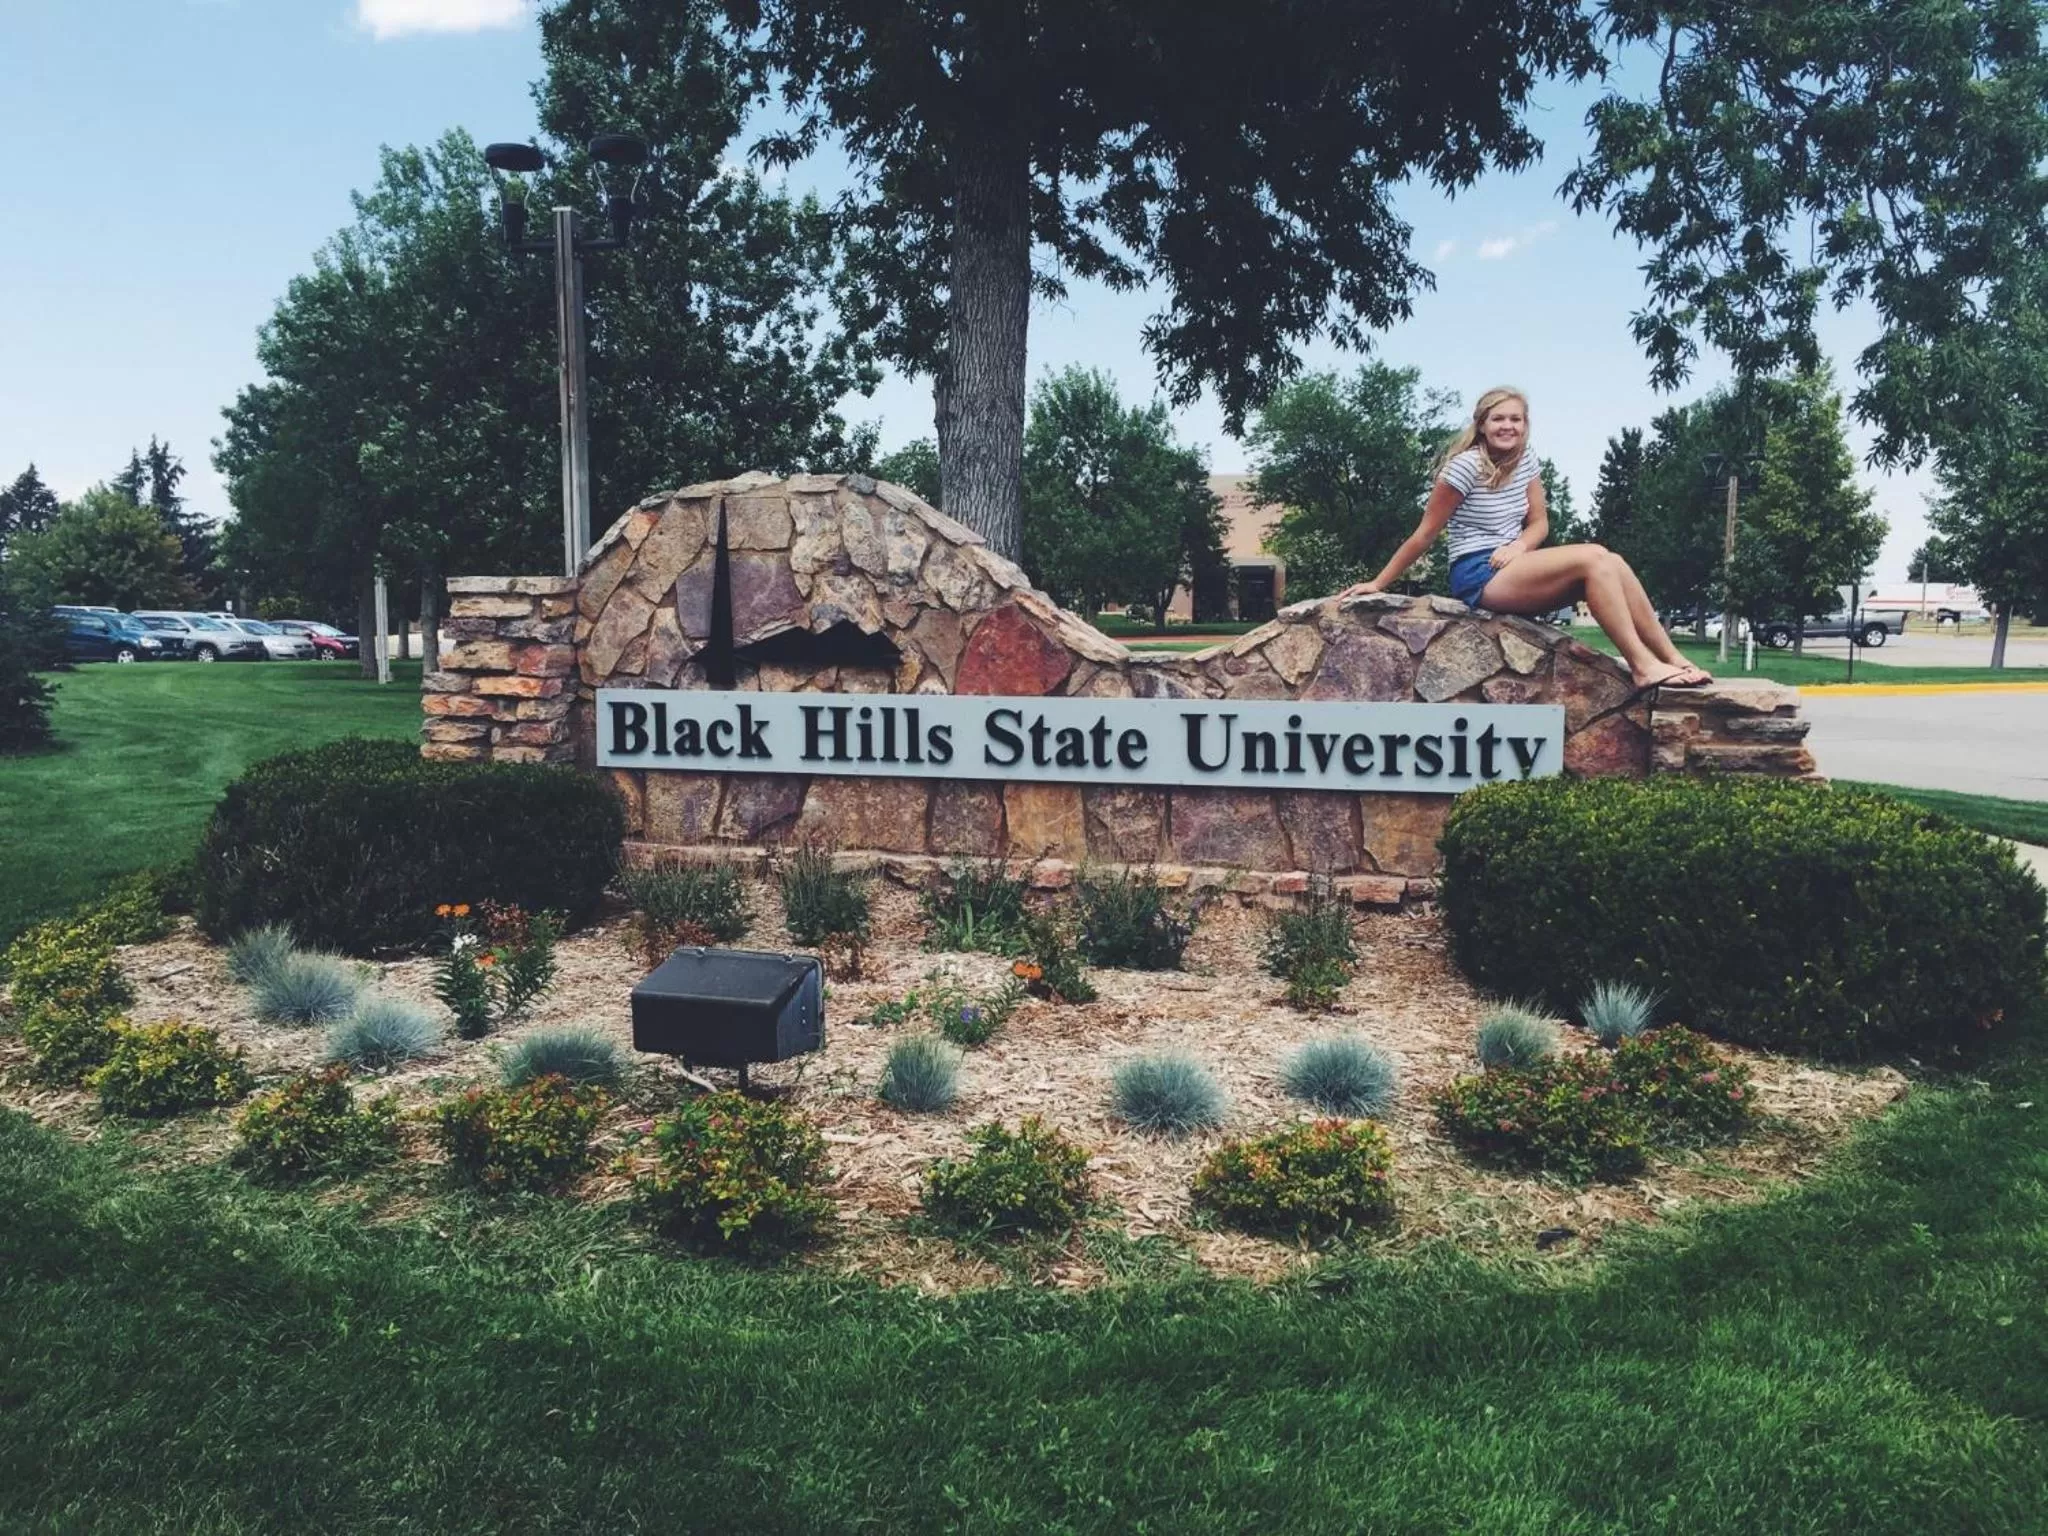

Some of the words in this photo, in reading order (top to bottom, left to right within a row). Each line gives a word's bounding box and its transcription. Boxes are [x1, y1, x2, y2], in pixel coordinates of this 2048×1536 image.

[608, 701, 773, 759] Black
[799, 705, 954, 765] Hills
[984, 709, 1148, 768] State
[1180, 713, 1547, 780] University
